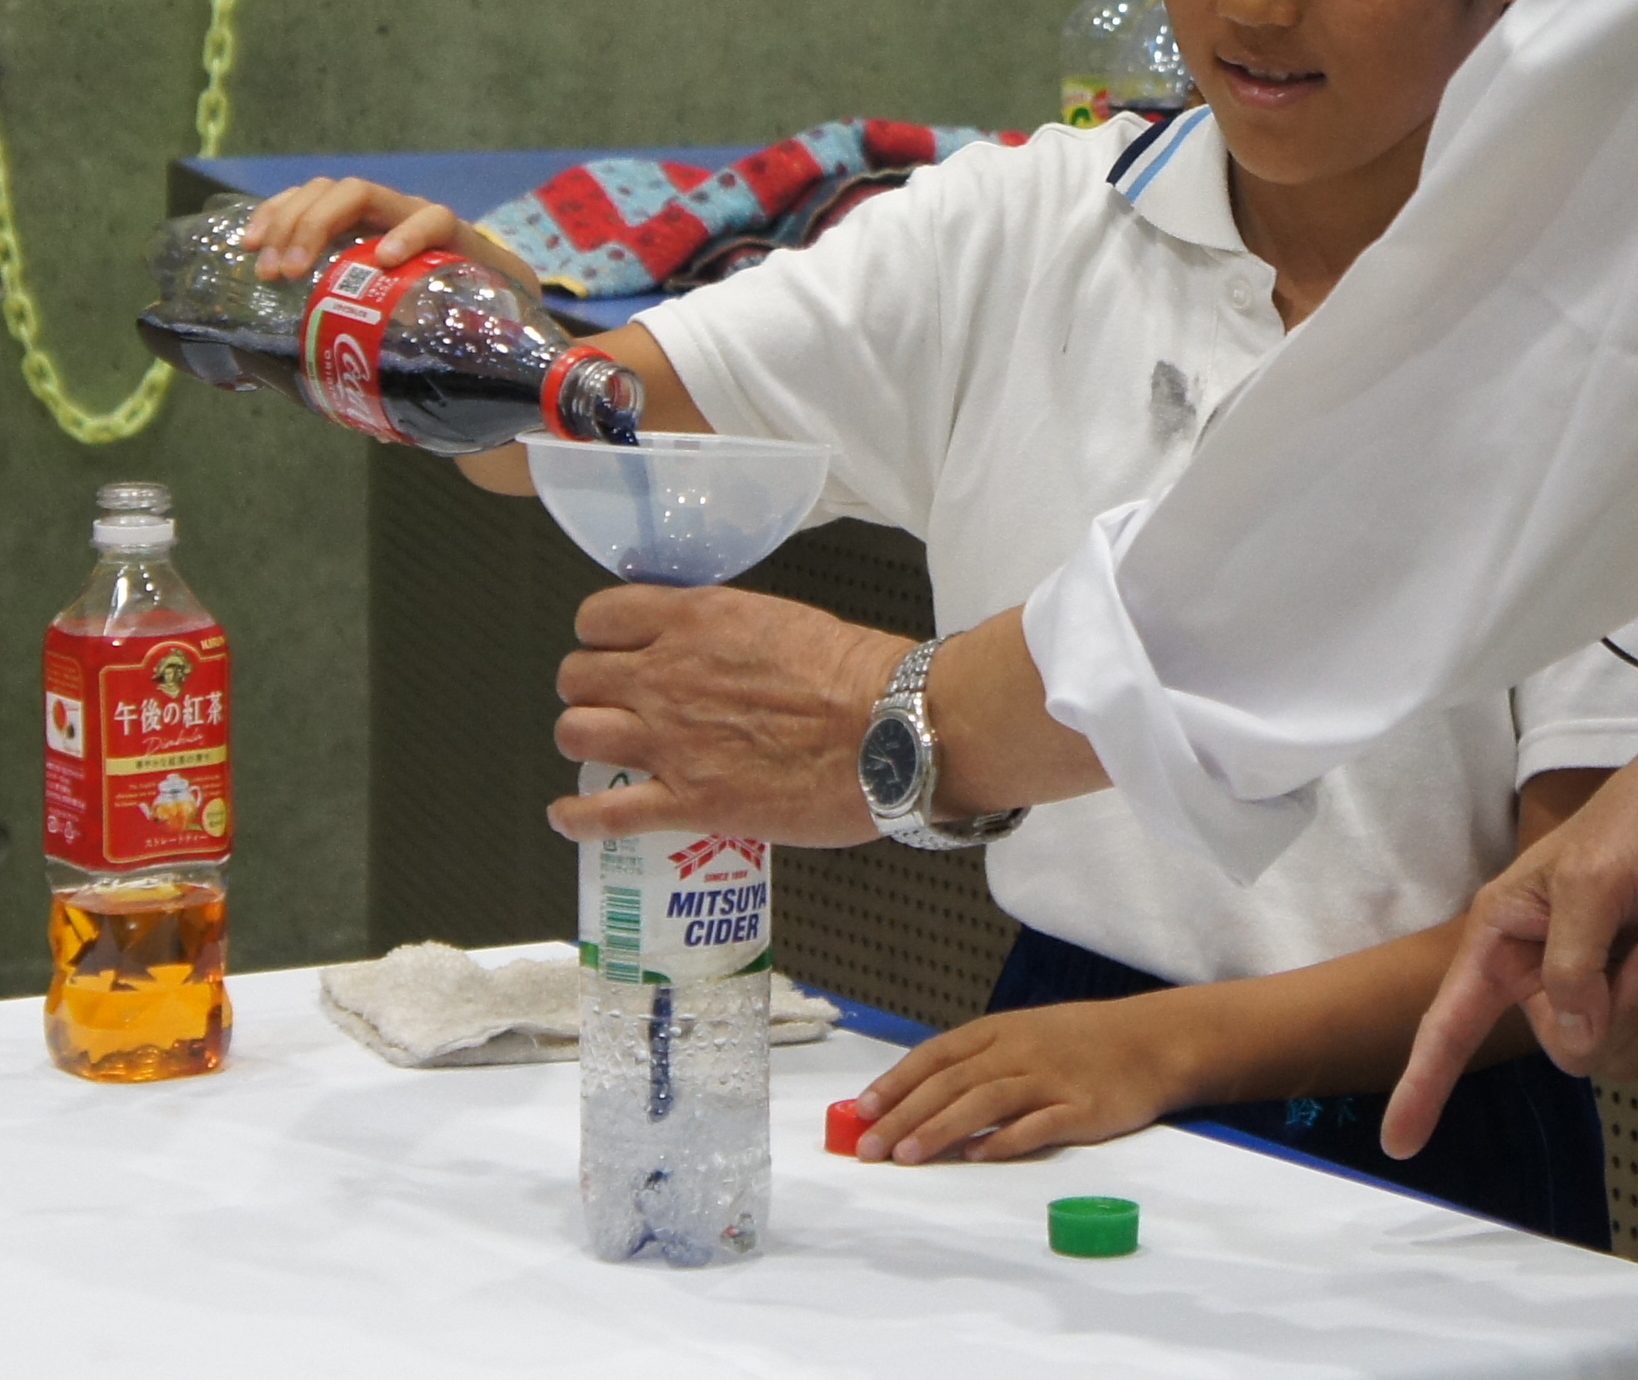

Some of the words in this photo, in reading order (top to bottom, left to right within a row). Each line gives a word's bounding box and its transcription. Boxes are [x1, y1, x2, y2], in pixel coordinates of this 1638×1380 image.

[114, 691, 223, 736] 午後の紅茶
[666, 881, 767, 919] MITSUYA
[683, 913, 760, 948] CIDER
